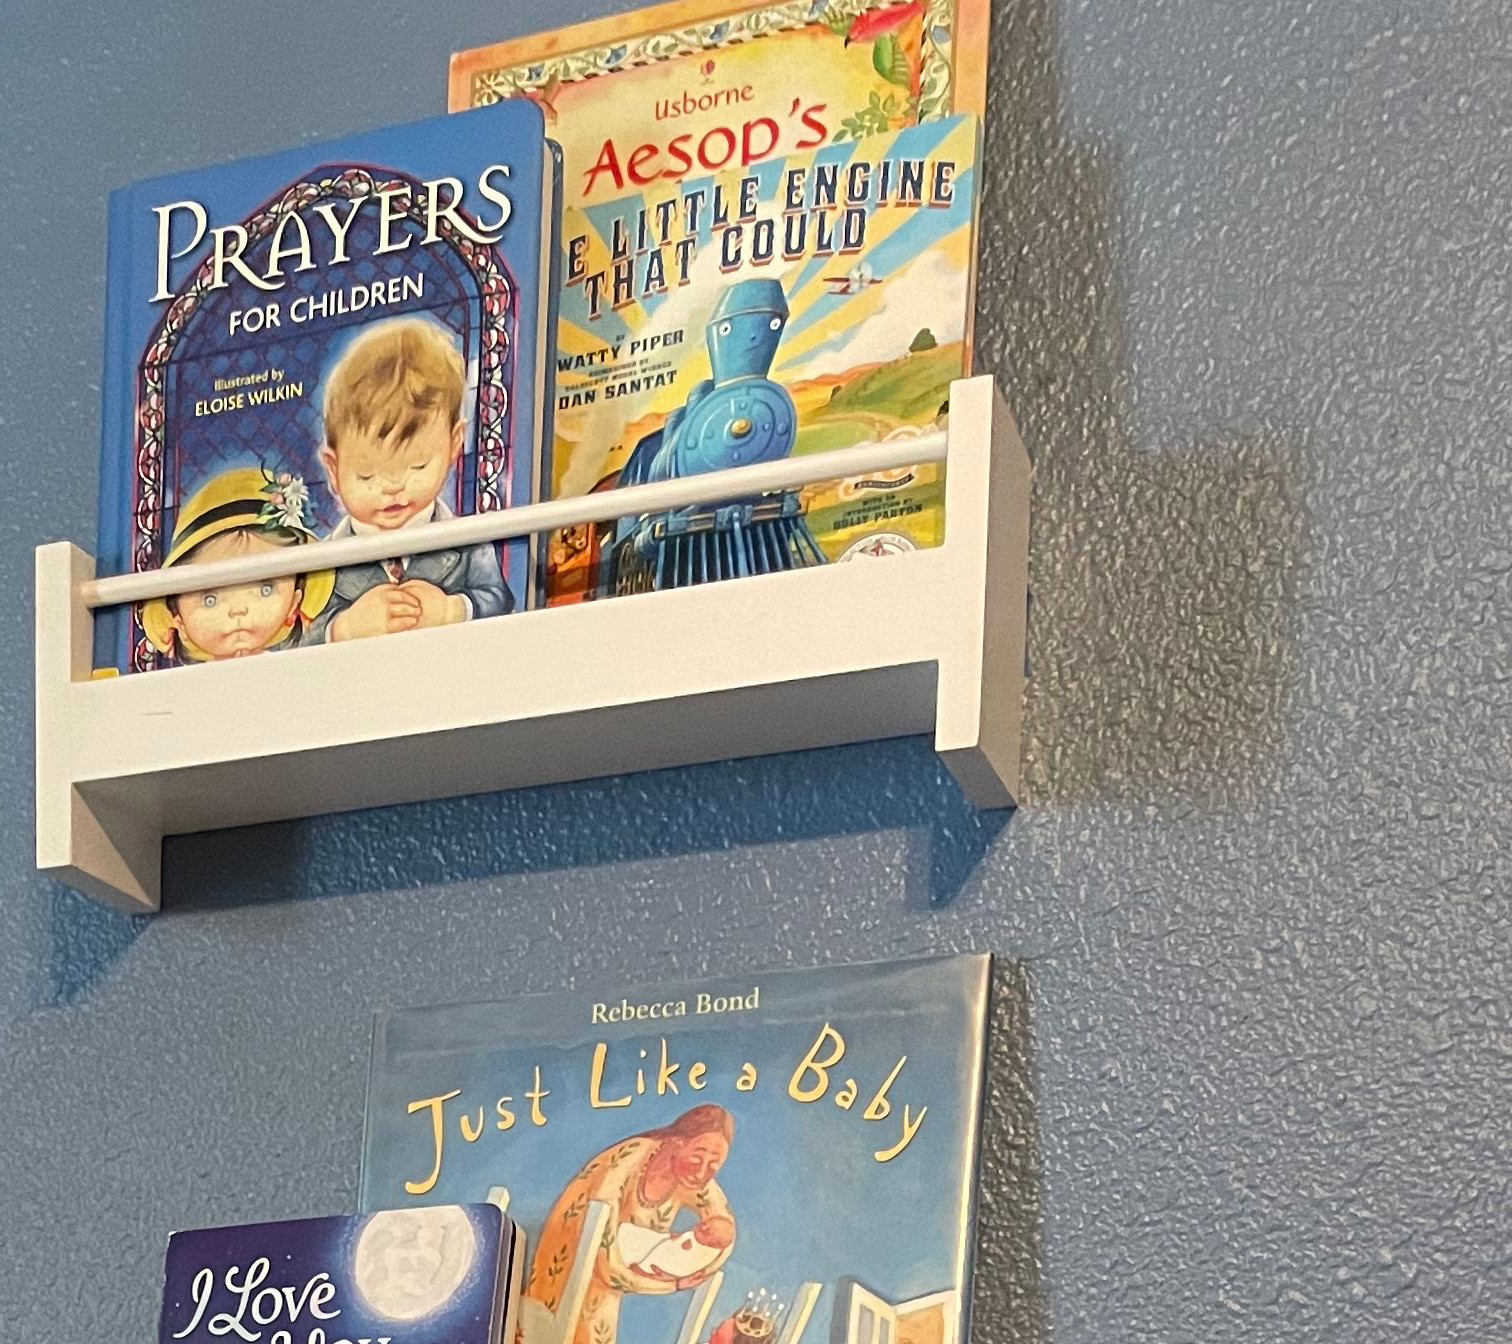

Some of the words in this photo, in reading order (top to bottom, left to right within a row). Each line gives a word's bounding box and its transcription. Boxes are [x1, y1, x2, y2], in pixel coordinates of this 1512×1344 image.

[583, 97, 828, 196] Aesop's
[148, 164, 512, 303] PRAYERS
[611, 176, 760, 265] LITTLE
[783, 160, 955, 217] ENGINE
[584, 238, 696, 321] THAT
[719, 207, 868, 274] COULD
[230, 306, 281, 336] FOR
[290, 273, 425, 324] CHILDREN
[214, 370, 268, 391] Illustrated
[272, 368, 285, 382] by
[557, 345, 620, 372] WATTY
[630, 330, 684, 355] PIPER
[195, 393, 244, 416] ELOISE
[248, 381, 303, 406] WILKIN
[559, 390, 596, 410] DAN
[605, 370, 677, 399] SANTAT
[591, 998, 686, 1025] Rebecca
[695, 987, 760, 1015] Bond
[404, 1066, 550, 1195] Just
[589, 1038, 707, 1109] Like
[736, 1061, 759, 1092] a
[788, 1022, 928, 1163] Baby
[173, 1268, 214, 1339] I
[208, 1257, 341, 1342] Love
